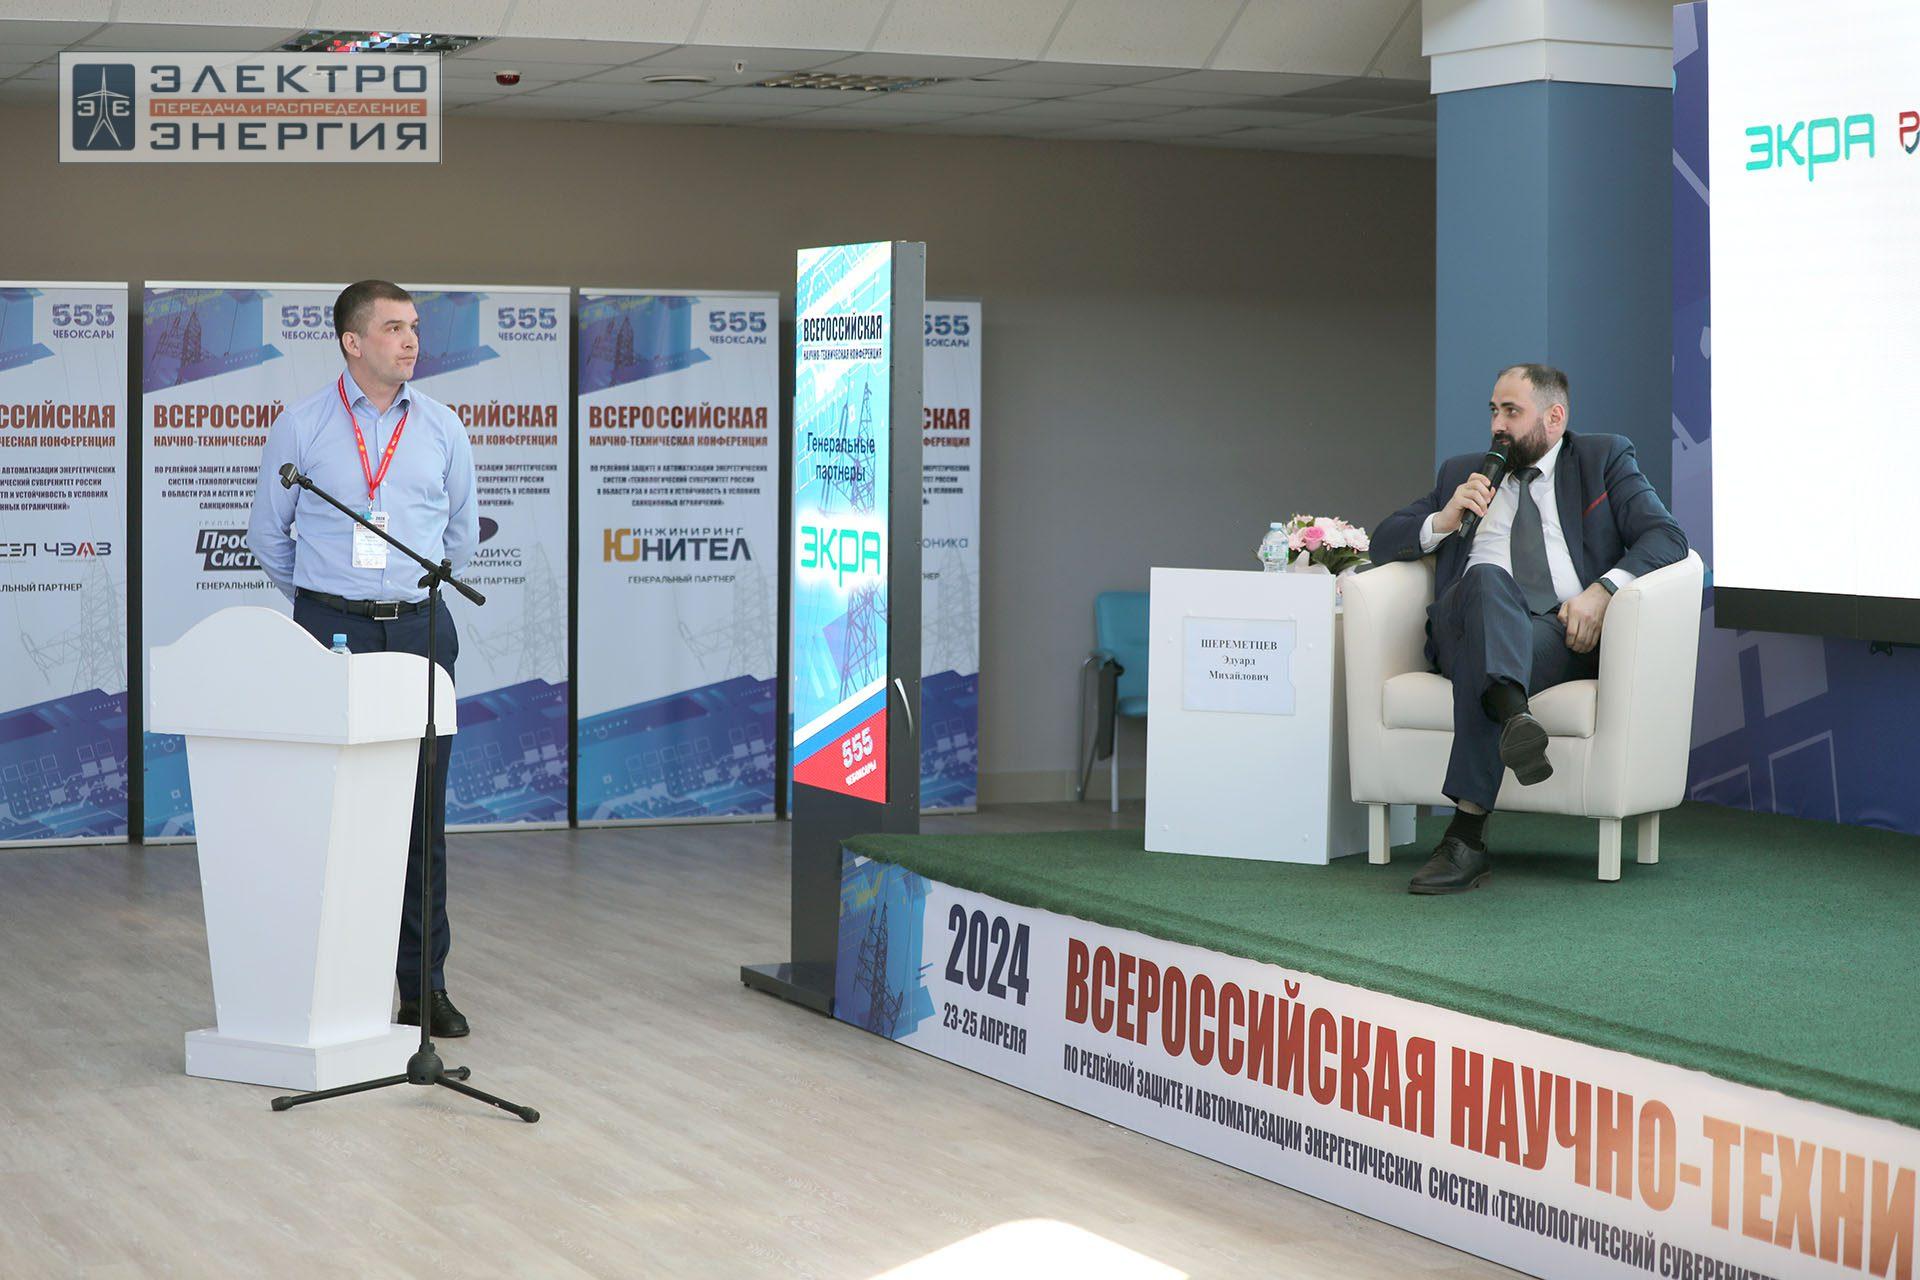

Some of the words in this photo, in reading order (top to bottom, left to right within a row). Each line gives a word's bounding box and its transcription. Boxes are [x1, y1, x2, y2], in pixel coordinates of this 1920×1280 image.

[52, 304, 115, 326] 555
[498, 308, 557, 329] 555
[709, 312, 767, 332] 555
[803, 312, 882, 342] ВСЕРОССИЙСКАЯ
[52, 330, 115, 339] ЧЕБОКСАРЫ
[498, 334, 557, 342] ЧЕБОКСАРЫ
[710, 336, 767, 344] ЧЕБОКСАРЫ
[803, 349, 849, 361] НАУЧНО-ТЕХНИЧЕСКАЯ
[850, 347, 882, 360] КОНФЕРЕНЦИЯ
[589, 402, 768, 429] ВСЕРОССИЙСКАЯ
[40, 436, 115, 448] КОНФЕРЕНЦИЯ
[154, 435, 267, 447] НАУЧНО-ТЕХНИЧЕСКАЯ
[486, 435, 558, 447] КОНФЕРЕНЦИЯ
[589, 435, 694, 446] НАУЧНО-ТЕХНИЧЕСКАЯ
[697, 436, 768, 447] КОНФЕРЕНЦИЯ
[807, 432, 876, 457] Генеральные
[2, 466, 58, 475] АВТОМАТИЗАЦИИ
[59, 466, 116, 474] ЭНЕРГЕТИЧЕСКИХ
[154, 466, 164, 474] ПО
[165, 465, 198, 474] РЕЛЕЙНОЙ
[199, 465, 224, 474] ЗАЩИТЕ
[816, 464, 866, 486] партнеры
[168, 478, 194, 486] СИСТЕМ
[15, 490, 66, 498] УСТОЙЧИВОСТЬ
[162, 490, 166, 498] В
[168, 490, 198, 498] ОБЛАСТИ
[199, 490, 211, 498] РЗА
[218, 490, 239, 498] АСУТП
[199, 502, 249, 510] САНКЦИОННЫХ
[633, 528, 744, 536] ИНЖИНИРИНГ
[603, 528, 752, 563] ЮНИТЕЛ
[196, 580, 264, 590] ГЕНЕРАЛЬНЫЙ
[628, 575, 692, 584] ГЕНЕРАЛЬНЫЙ
[38, 583, 82, 592] ПАРТНЕР
[1200, 639, 1278, 651] ШЕРЕМЕТЦЕВ
[1223, 655, 1256, 667] Эдуард
[1209, 670, 1270, 681] Михайлович
[842, 727, 873, 768] 555
[945, 904, 1031, 1006] 2024
[943, 1002, 978, 1038] 23-25
[979, 1014, 1028, 1055] АПРЕЛЯ
[1065, 937, 1436, 1138] ВСЕРОССИЙСКАЯ
[1450, 1046, 1916, 1280] НАУЧНО-ТЕХНИ
[1064, 1044, 1078, 1073] ПО
[1080, 1049, 1135, 1093] РЕЛЕЙНОЙ
[1136, 1069, 1183, 1110] ЗАЩИТЕ
[1185, 1086, 1193, 1114] И
[1195, 1088, 1302, 1152] АВТОМАТИЗАЦИИ
[1304, 1125, 1422, 1194] ЭНЕРГЕТИЧЕСКИХ
[1428, 1166, 1489, 1216] СИСТЕМ
[1492, 1189, 1656, 1273] «ТЕХНОЛОГИЧЕСКИЙ
